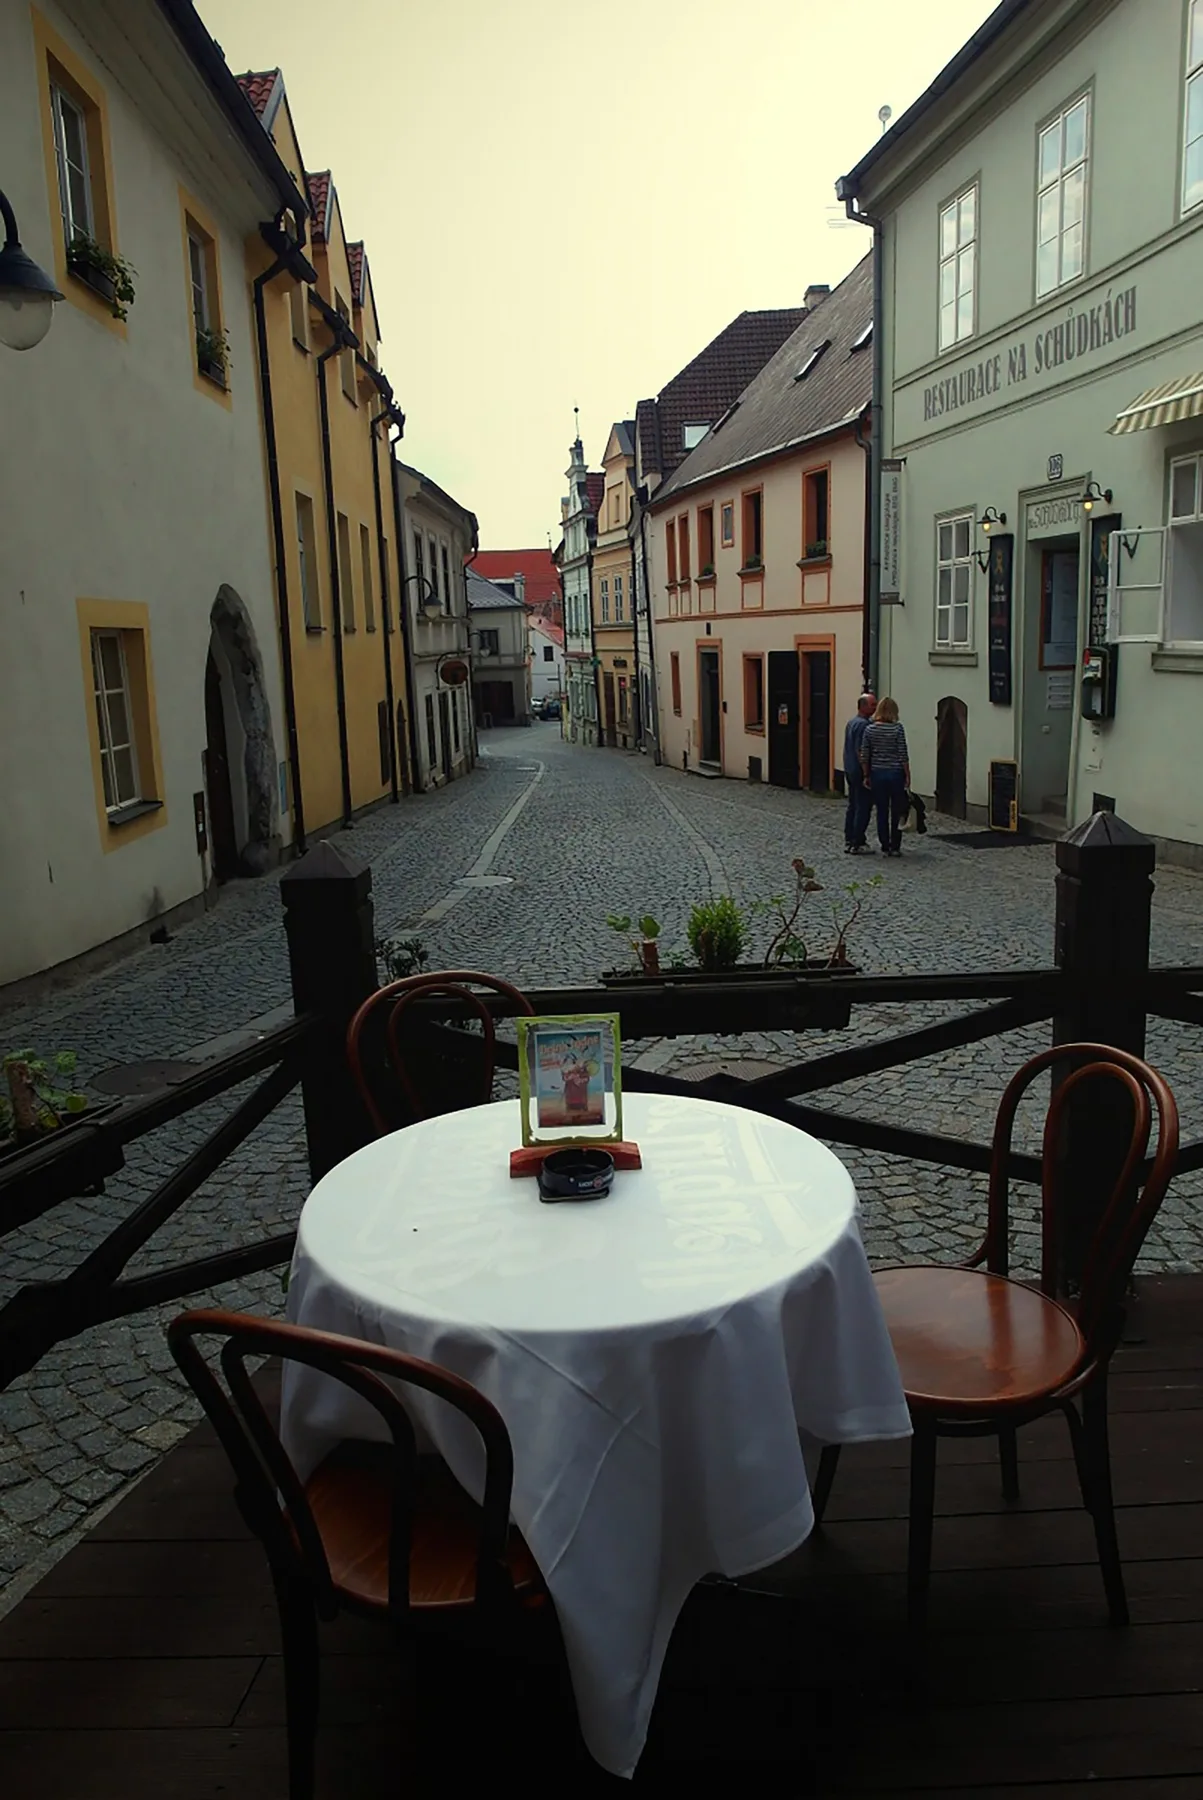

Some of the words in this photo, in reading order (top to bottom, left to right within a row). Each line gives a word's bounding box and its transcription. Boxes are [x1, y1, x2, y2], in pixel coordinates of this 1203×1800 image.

[923, 351, 1001, 422] RESTAURACE
[1007, 342, 1028, 387] NA
[1034, 285, 1137, 375] SCHŮDKÁCH
